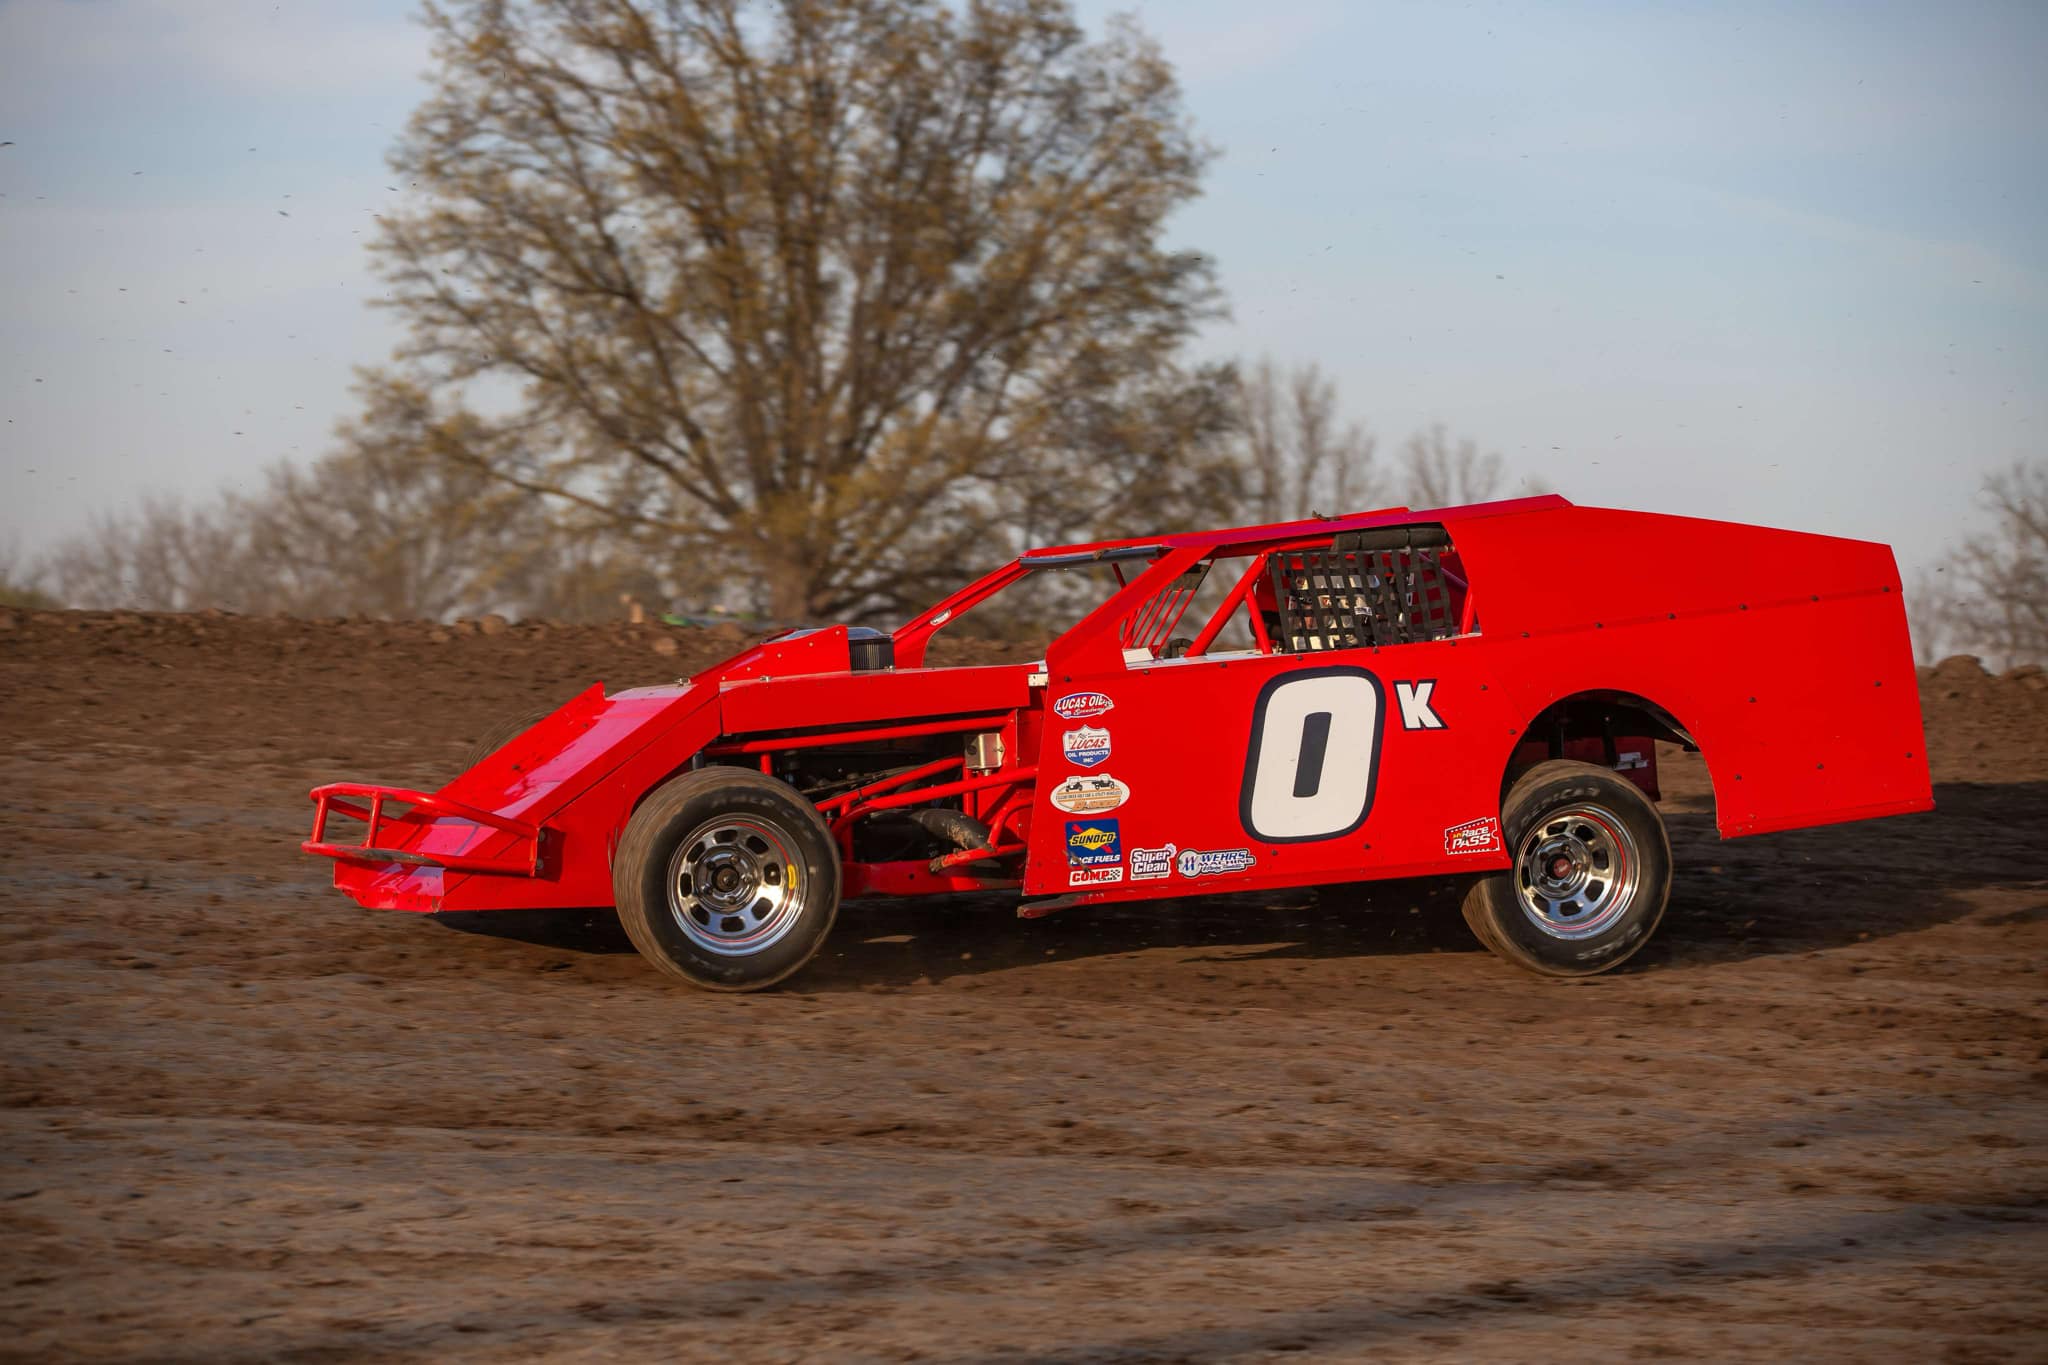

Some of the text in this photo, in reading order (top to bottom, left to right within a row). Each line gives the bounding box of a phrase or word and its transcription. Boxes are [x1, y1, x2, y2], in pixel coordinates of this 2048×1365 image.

[1056, 695, 1104, 711] LUCAS OIL
[1393, 679, 1449, 731] K
[1071, 738, 1107, 750] LUCAS
[1071, 833, 1114, 845] SUNOCO
[1452, 833, 1491, 849] PASS
[1094, 855, 1121, 863] FUELS
[1133, 851, 1170, 863] Super
[1200, 851, 1248, 862] WEHRS
[1134, 862, 1168, 873] Clean
[1072, 870, 1110, 882] COMP
